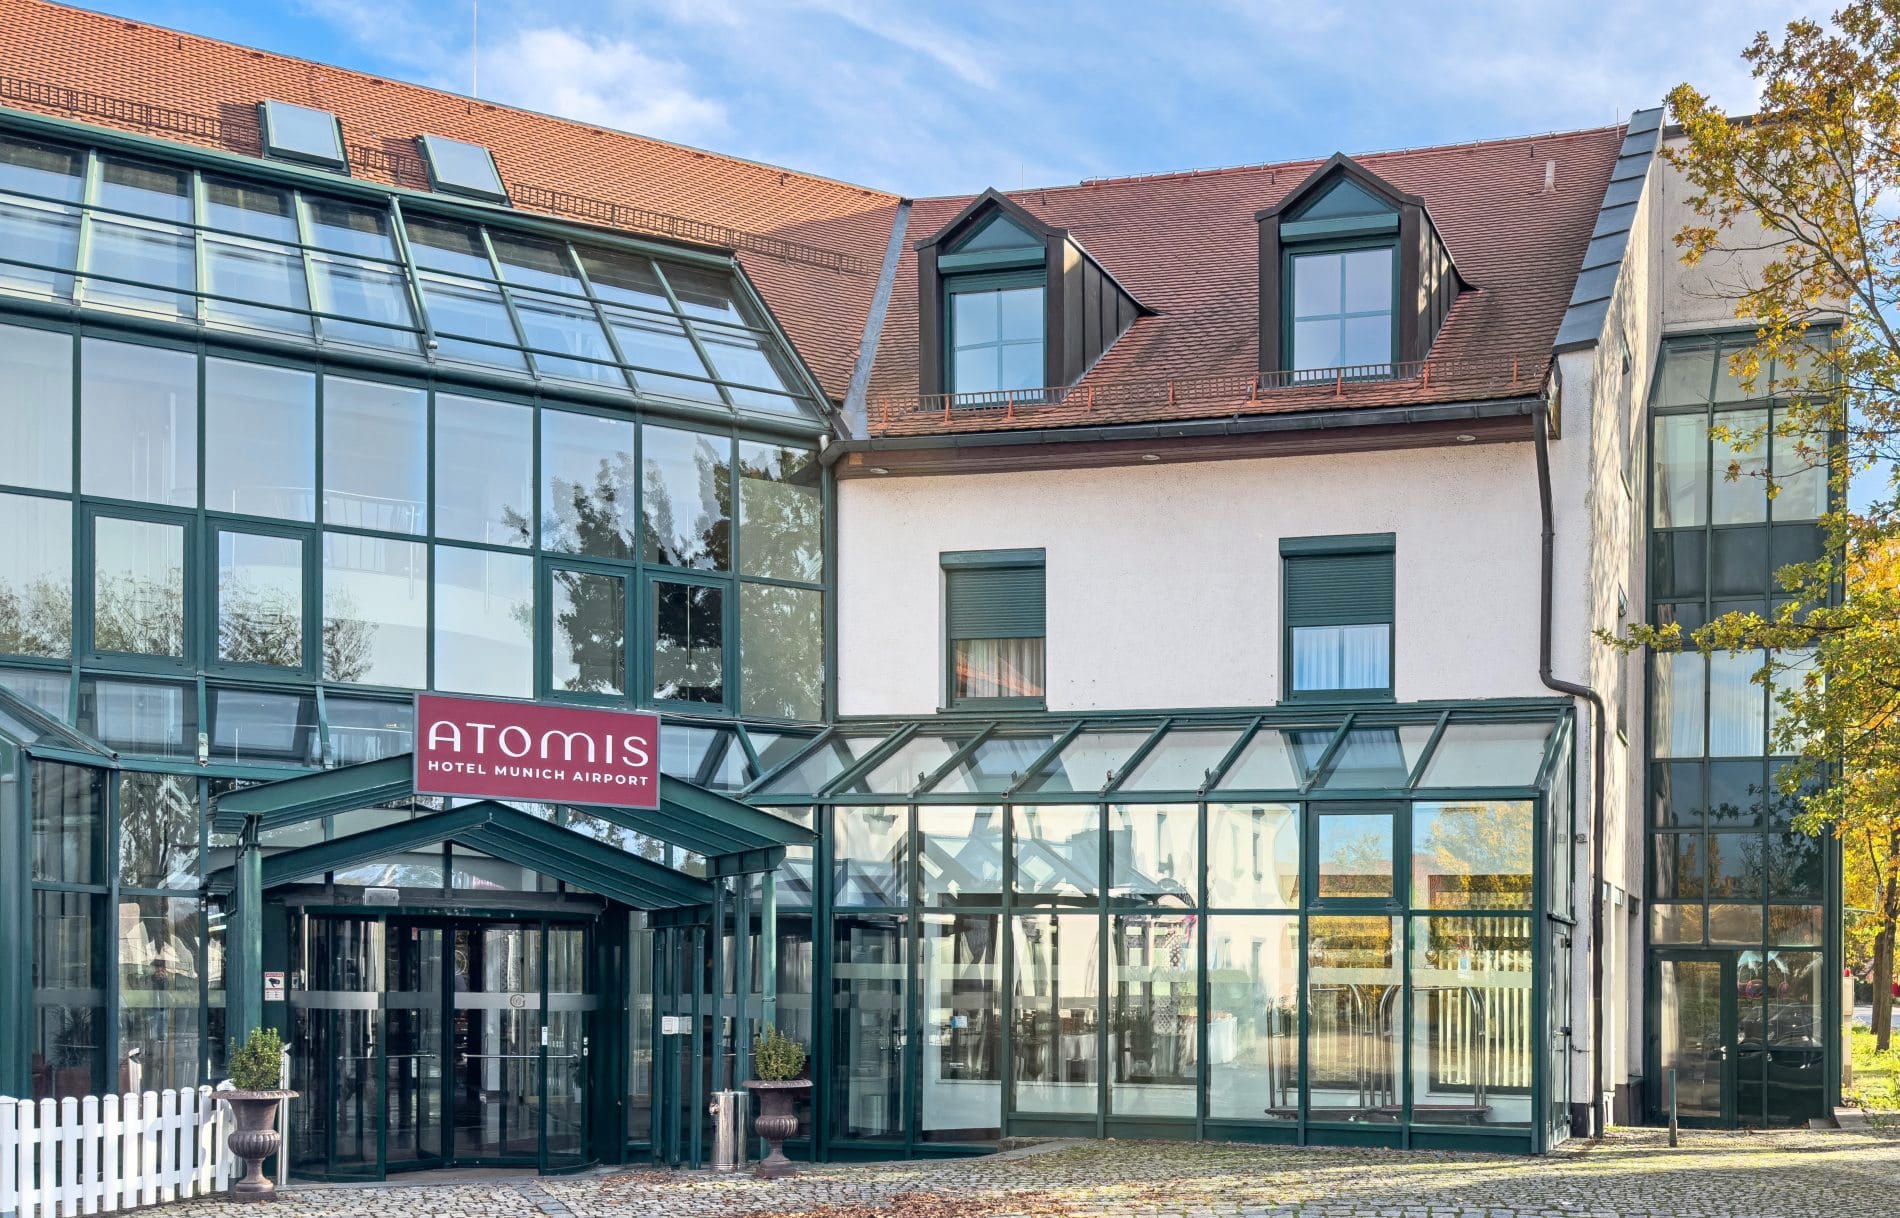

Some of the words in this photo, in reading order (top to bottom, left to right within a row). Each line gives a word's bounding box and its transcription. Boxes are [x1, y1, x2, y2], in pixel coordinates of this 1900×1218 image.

[428, 720, 649, 767] ATOMIS
[428, 760, 487, 775] HOTEL
[494, 765, 565, 781] MUNICH
[572, 771, 649, 786] AIRPORT
